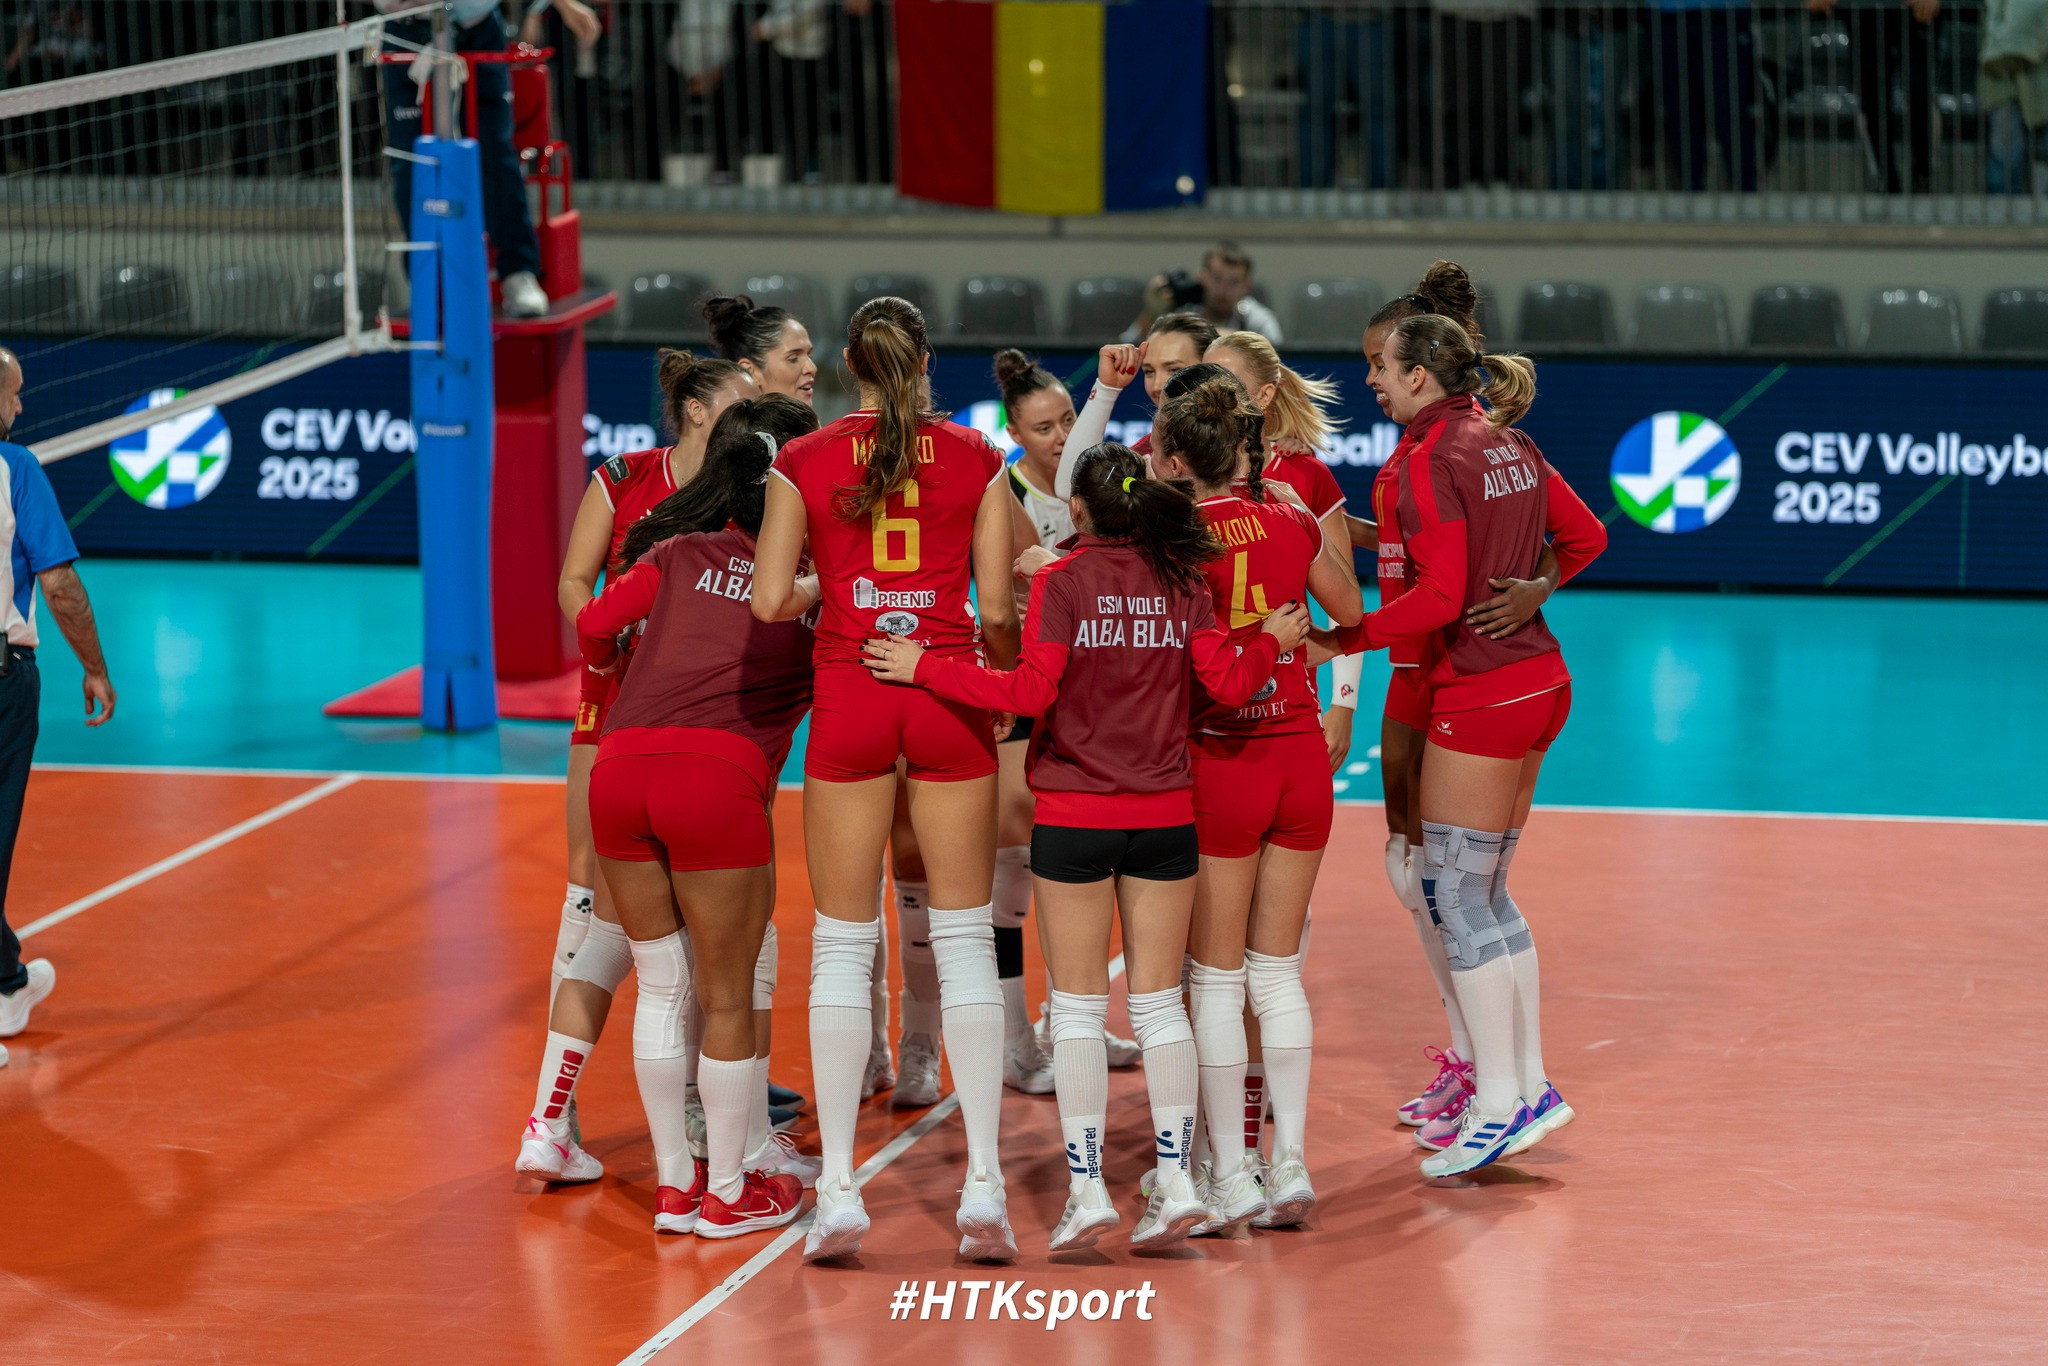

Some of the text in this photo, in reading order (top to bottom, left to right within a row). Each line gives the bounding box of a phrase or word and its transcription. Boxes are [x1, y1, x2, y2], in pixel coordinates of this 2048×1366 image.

[261, 408, 351, 450] CEV
[257, 456, 360, 500] 2025
[1774, 431, 2048, 486] CEV Volleyb
[1773, 481, 1882, 524] 2025
[871, 478, 920, 572] 6
[877, 590, 936, 608] PRENIS
[1126, 596, 1167, 615] VOLEI
[1230, 550, 1275, 630] 4
[1074, 618, 1187, 648] ALBA BLAJ
[1178, 1116, 1194, 1171] ninesquared
